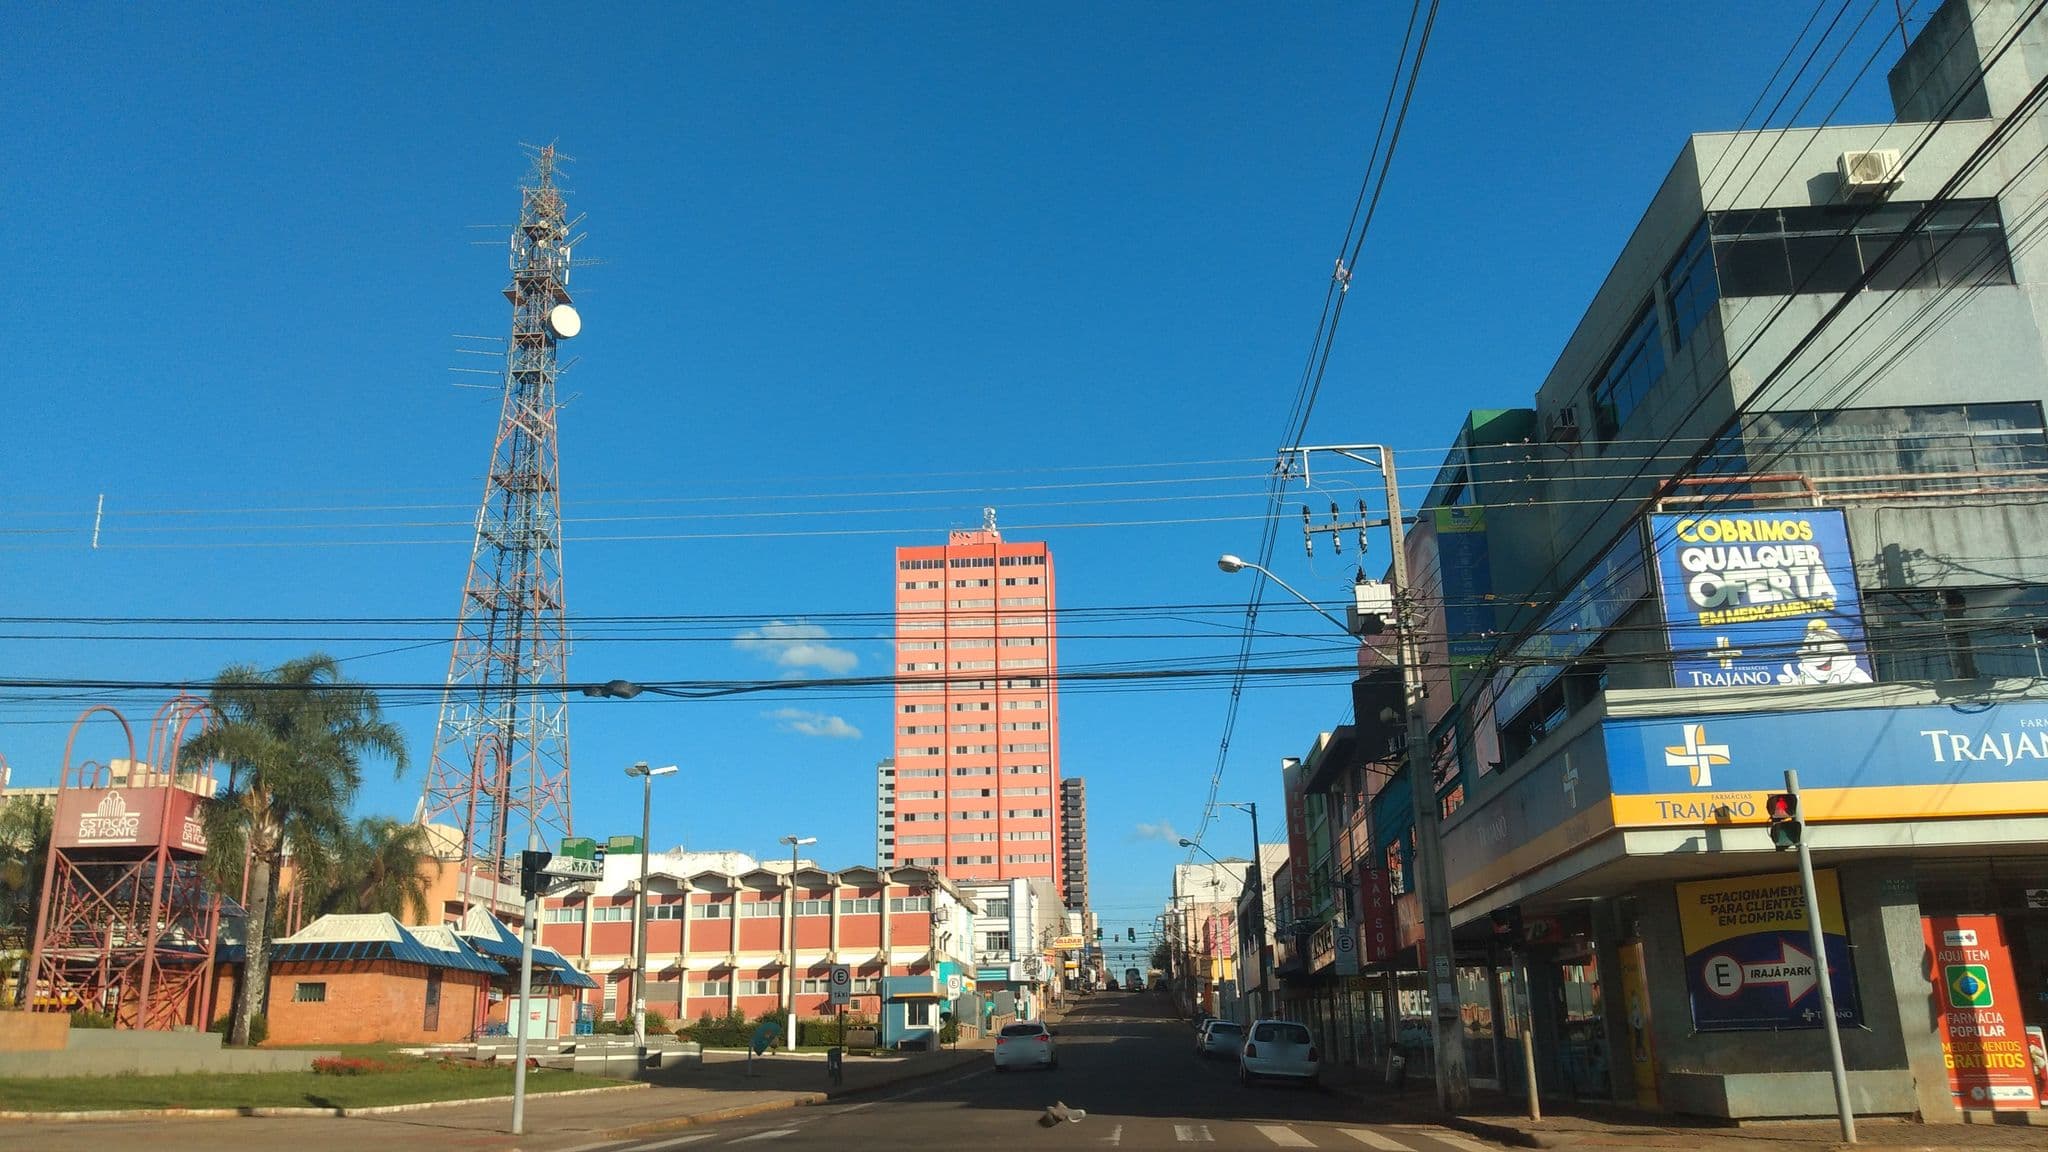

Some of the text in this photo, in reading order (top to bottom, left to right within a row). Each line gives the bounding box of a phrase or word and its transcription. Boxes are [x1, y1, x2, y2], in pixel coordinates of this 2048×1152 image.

[1676, 519, 1814, 543] COBRIMOS
[1681, 545, 1824, 573] QUALQUER
[1689, 565, 1837, 607] OFERTA
[1699, 598, 1835, 626] EM MEDICAMENTOS
[1688, 671, 1771, 687] TRAJANO
[1656, 800, 1755, 820] TRAJANO
[79, 827, 138, 838] DA FONTE
[183, 822, 202, 834] ESTA
[1700, 885, 1804, 906] ESTACIONAMENT
[1711, 896, 1807, 915] PARA CLIENTES
[1719, 909, 1802, 926] EM COMPRAS
[1939, 949, 1990, 962] AQUI TEM
[837, 972, 844, 981] E
[1715, 963, 1812, 987] E IRAJÁ PARK
[1946, 1009, 2005, 1024] FARMÁCIA
[1950, 1025, 2007, 1037] POPULAR
[1941, 1041, 2022, 1053] MEDICAMENTOS
[1943, 1052, 2026, 1069] GRATUITOS
